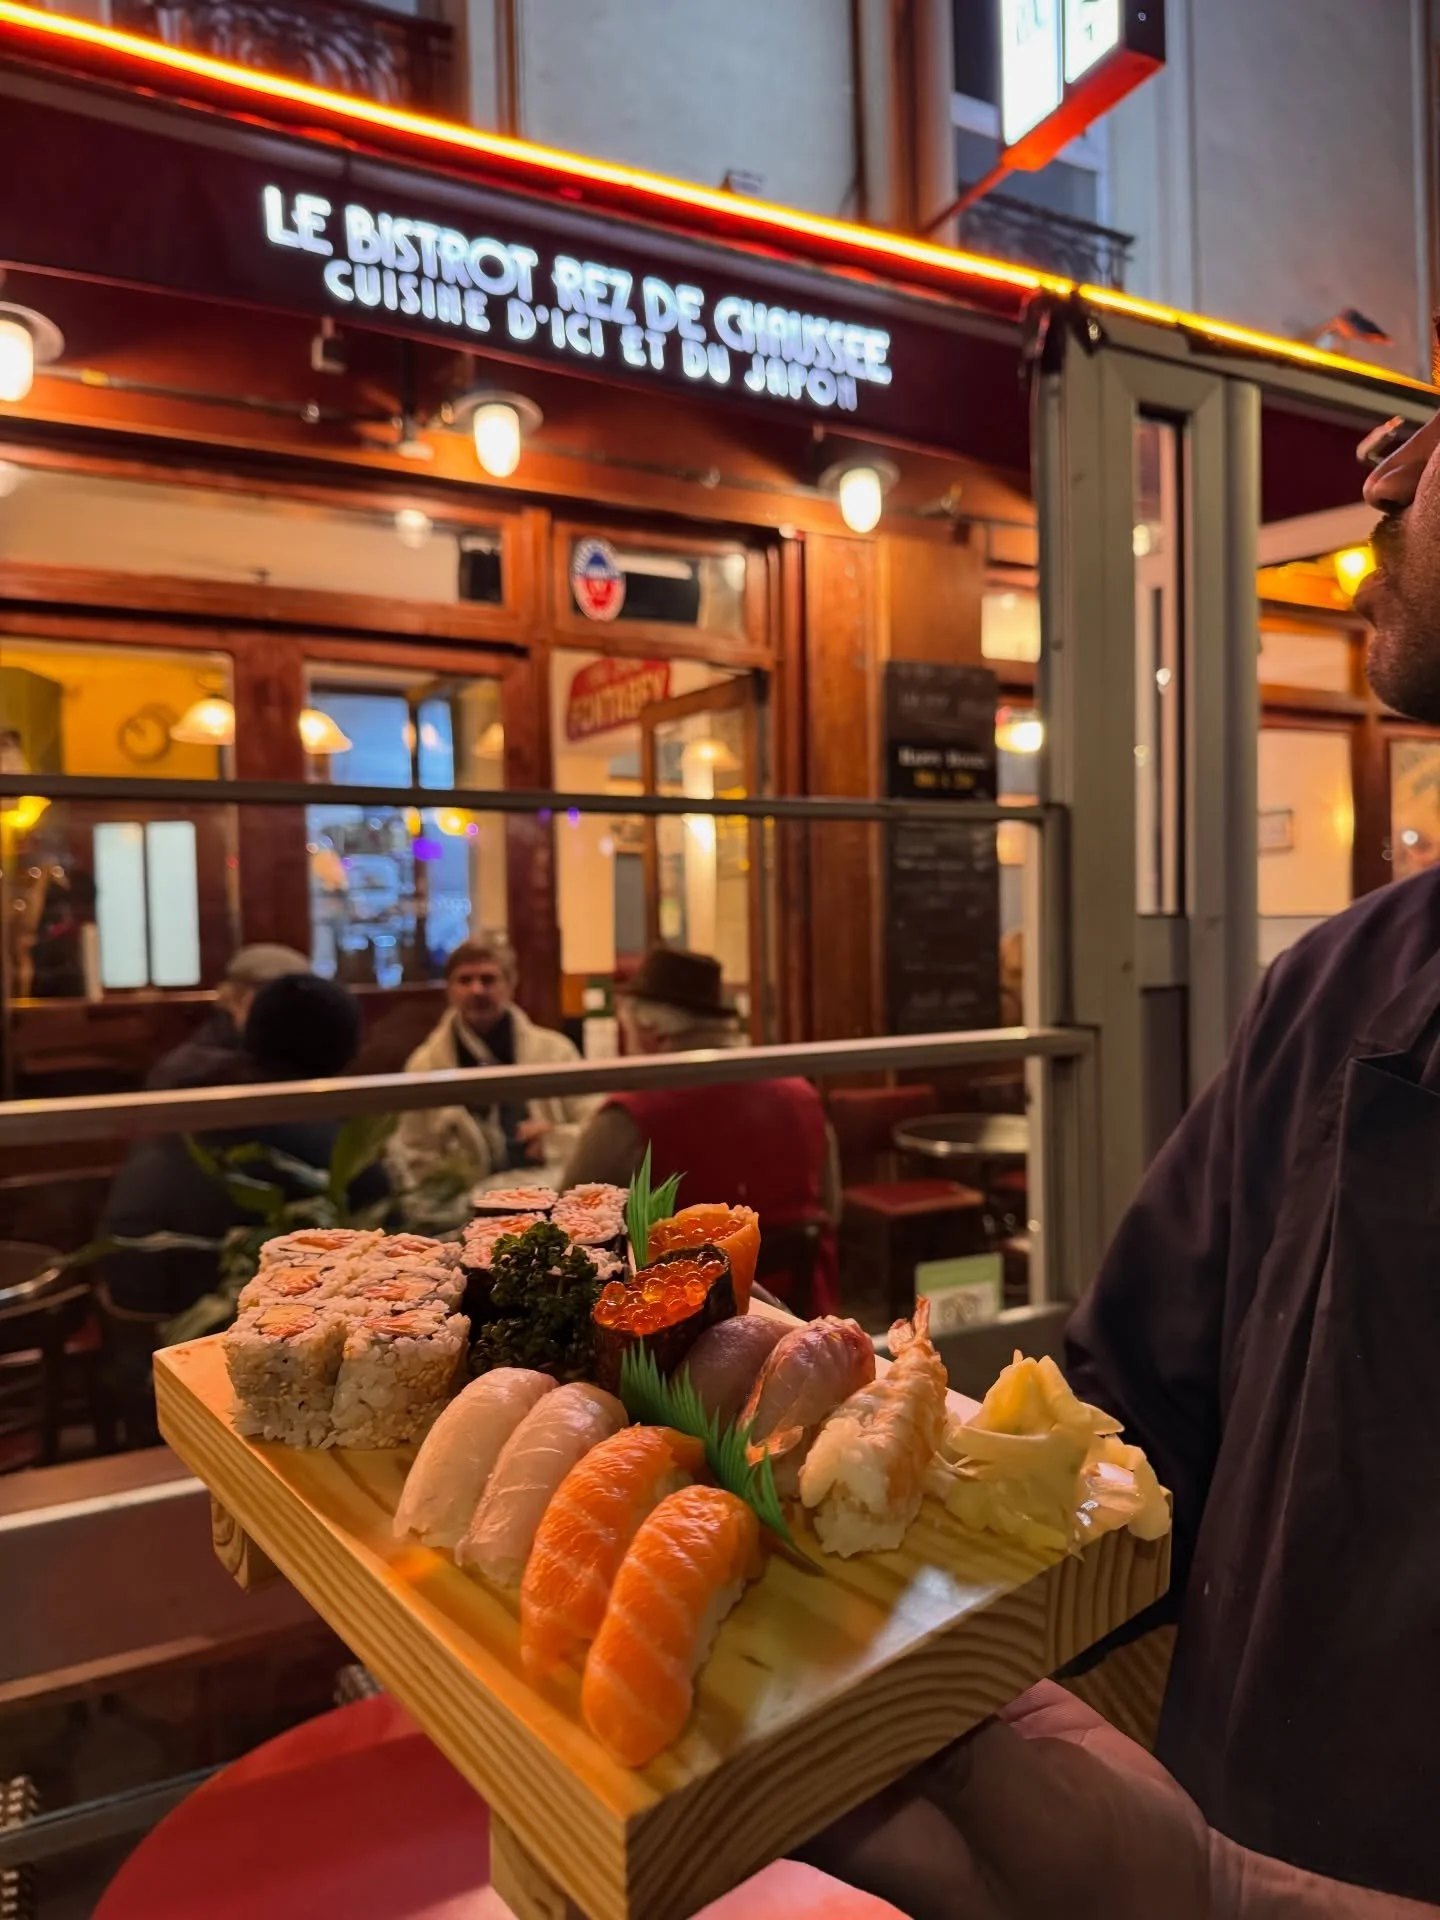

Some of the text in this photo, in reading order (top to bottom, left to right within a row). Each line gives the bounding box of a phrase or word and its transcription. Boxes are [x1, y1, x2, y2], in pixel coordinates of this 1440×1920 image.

[263, 185, 892, 384] LE BISTROT REZ DE CHAUSSEE
[324, 259, 858, 411] CUISINE D'ICI ET DU JAPON
